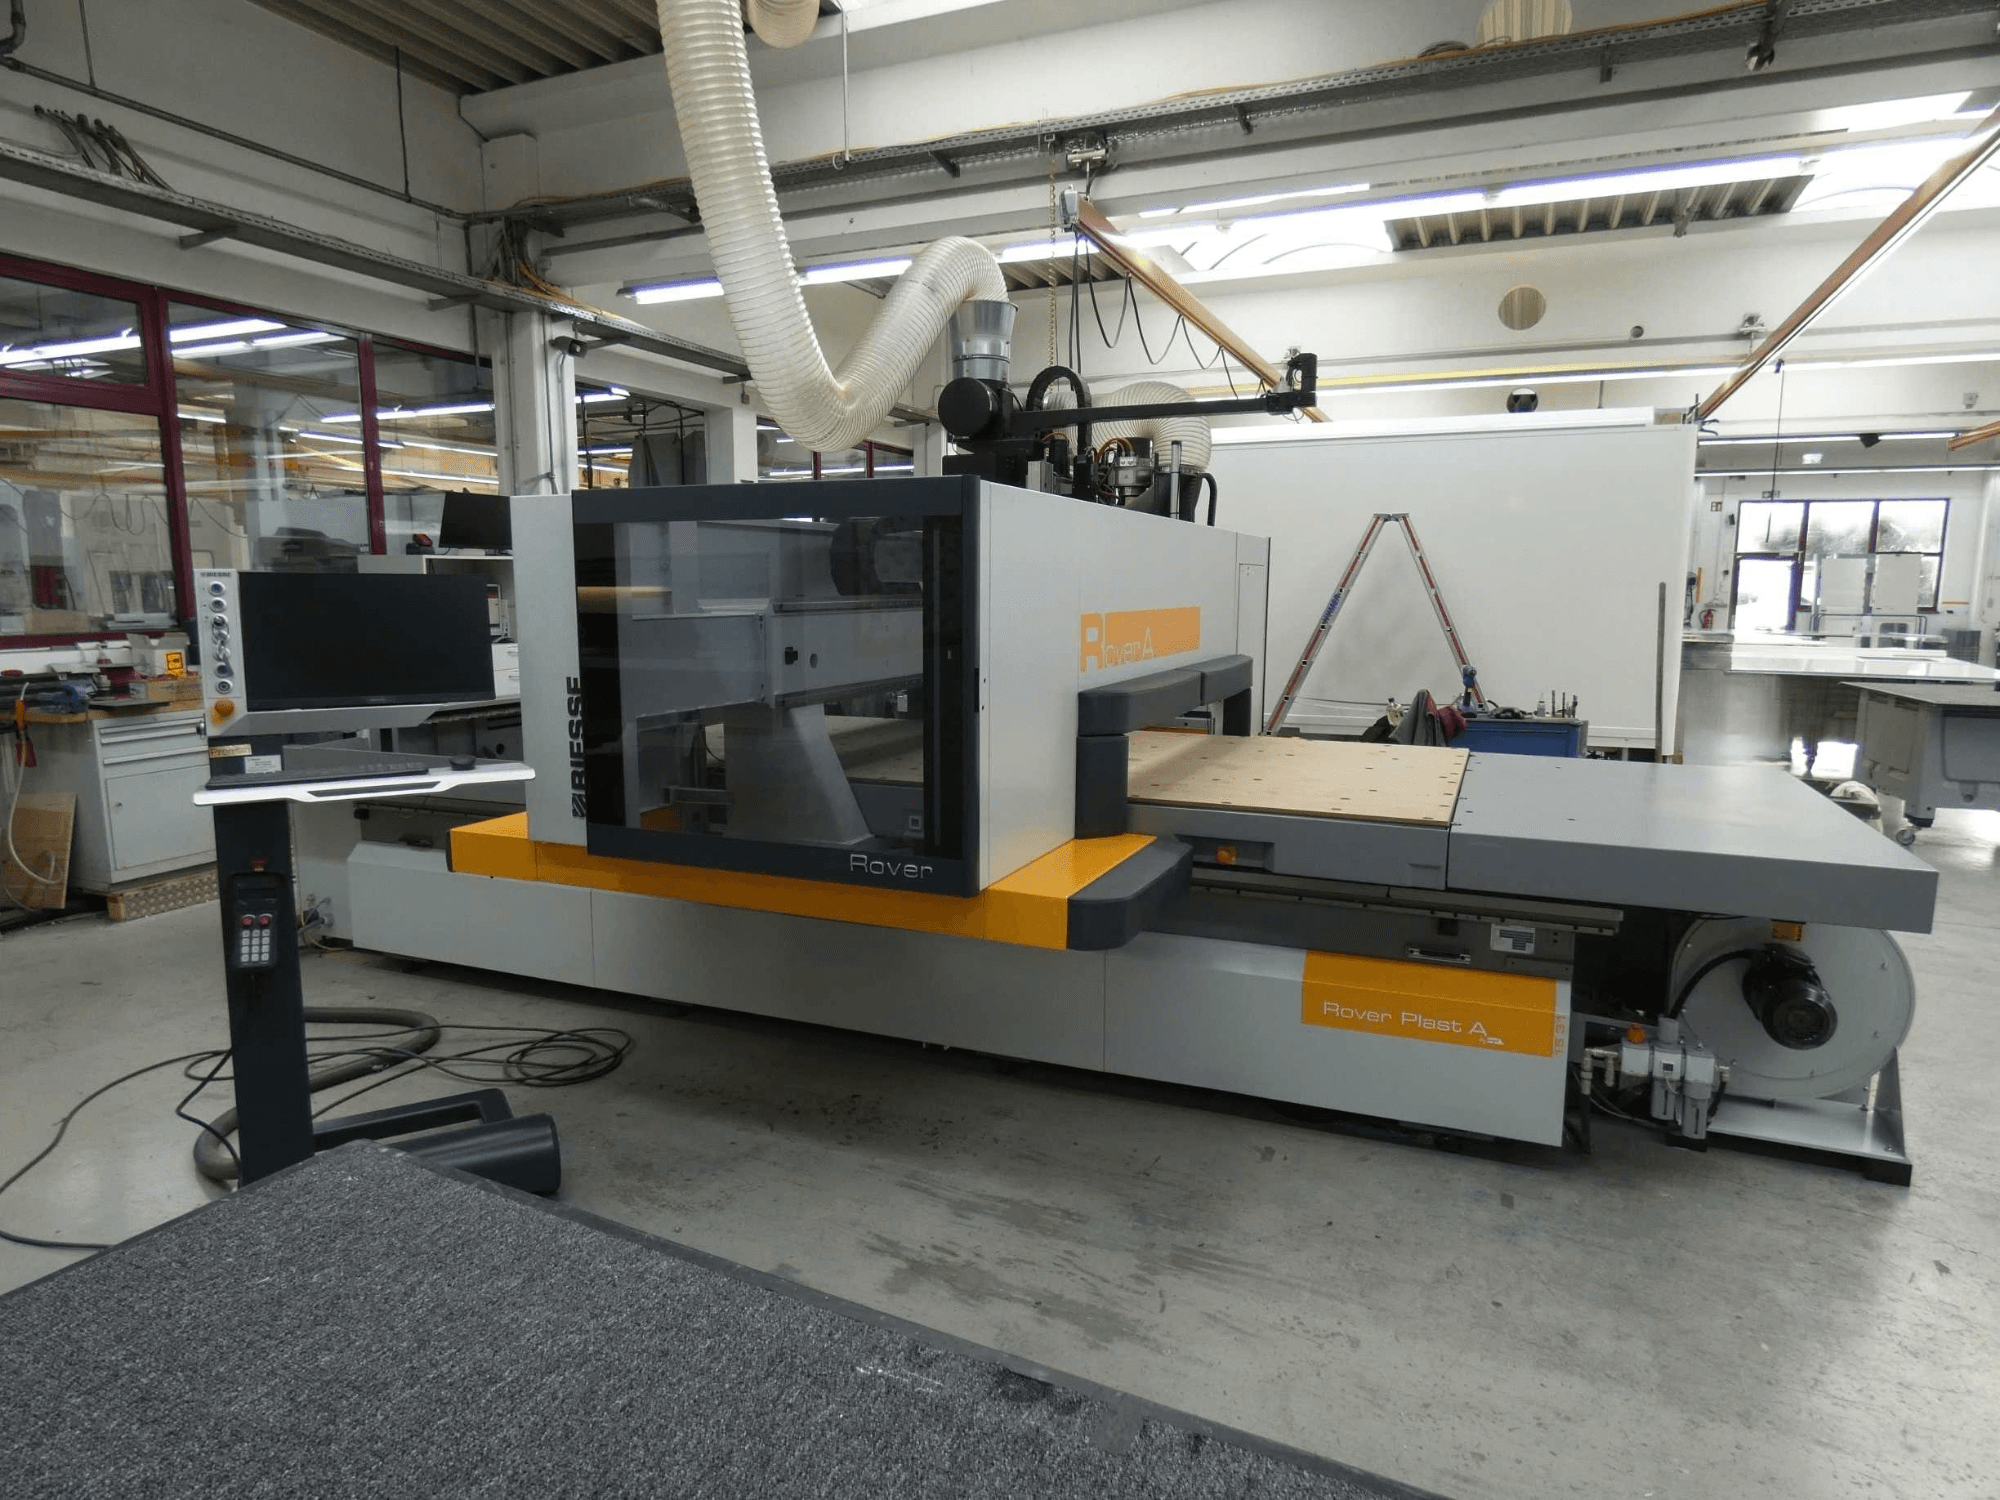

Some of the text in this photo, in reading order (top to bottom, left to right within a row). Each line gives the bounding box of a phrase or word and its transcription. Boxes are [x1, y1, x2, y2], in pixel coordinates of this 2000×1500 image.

[566, 676, 586, 791] BIESSE
[850, 853, 933, 879] Rover
[1323, 1001, 1487, 1037] Rover Plast A
